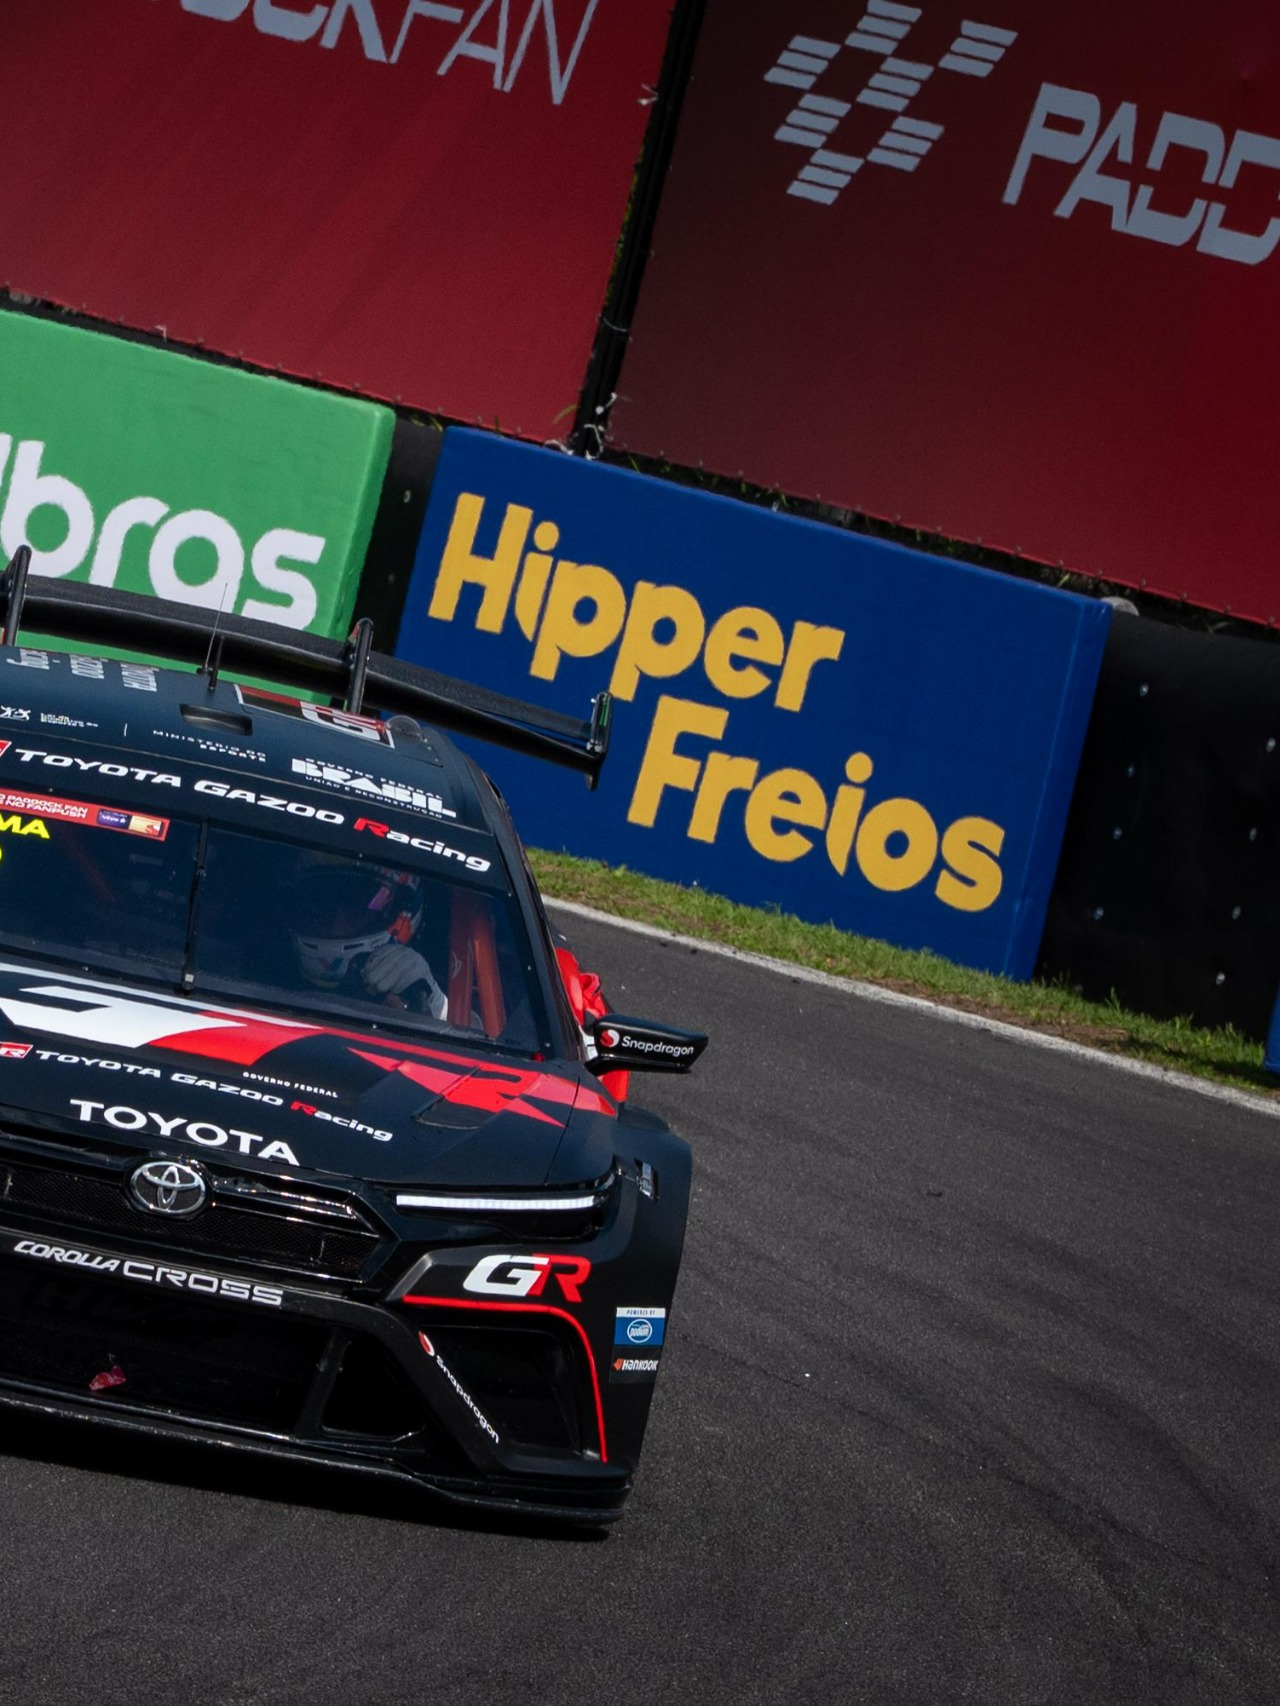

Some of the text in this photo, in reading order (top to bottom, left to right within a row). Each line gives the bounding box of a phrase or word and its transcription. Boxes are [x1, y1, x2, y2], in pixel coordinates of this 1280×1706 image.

[427, 491, 847, 713] Hipper
[15, 748, 182, 788] TOYOTA
[194, 779, 345, 825] GAZOO
[353, 817, 491, 872] Racing
[627, 695, 1006, 913] Freios
[242, 1071, 338, 1098] GOVERNO FEDERAL
[621, 1036, 694, 1057] Snapdragon
[35, 1050, 162, 1078] TOYOTA
[171, 1073, 284, 1106] GAZOO
[290, 1101, 394, 1142] Racing
[70, 1099, 300, 1166] TOYOTA
[14, 1240, 284, 1306] COROLLA CROSS
[462, 1253, 593, 1303] GR
[435, 1354, 501, 1444] Snapdragon
